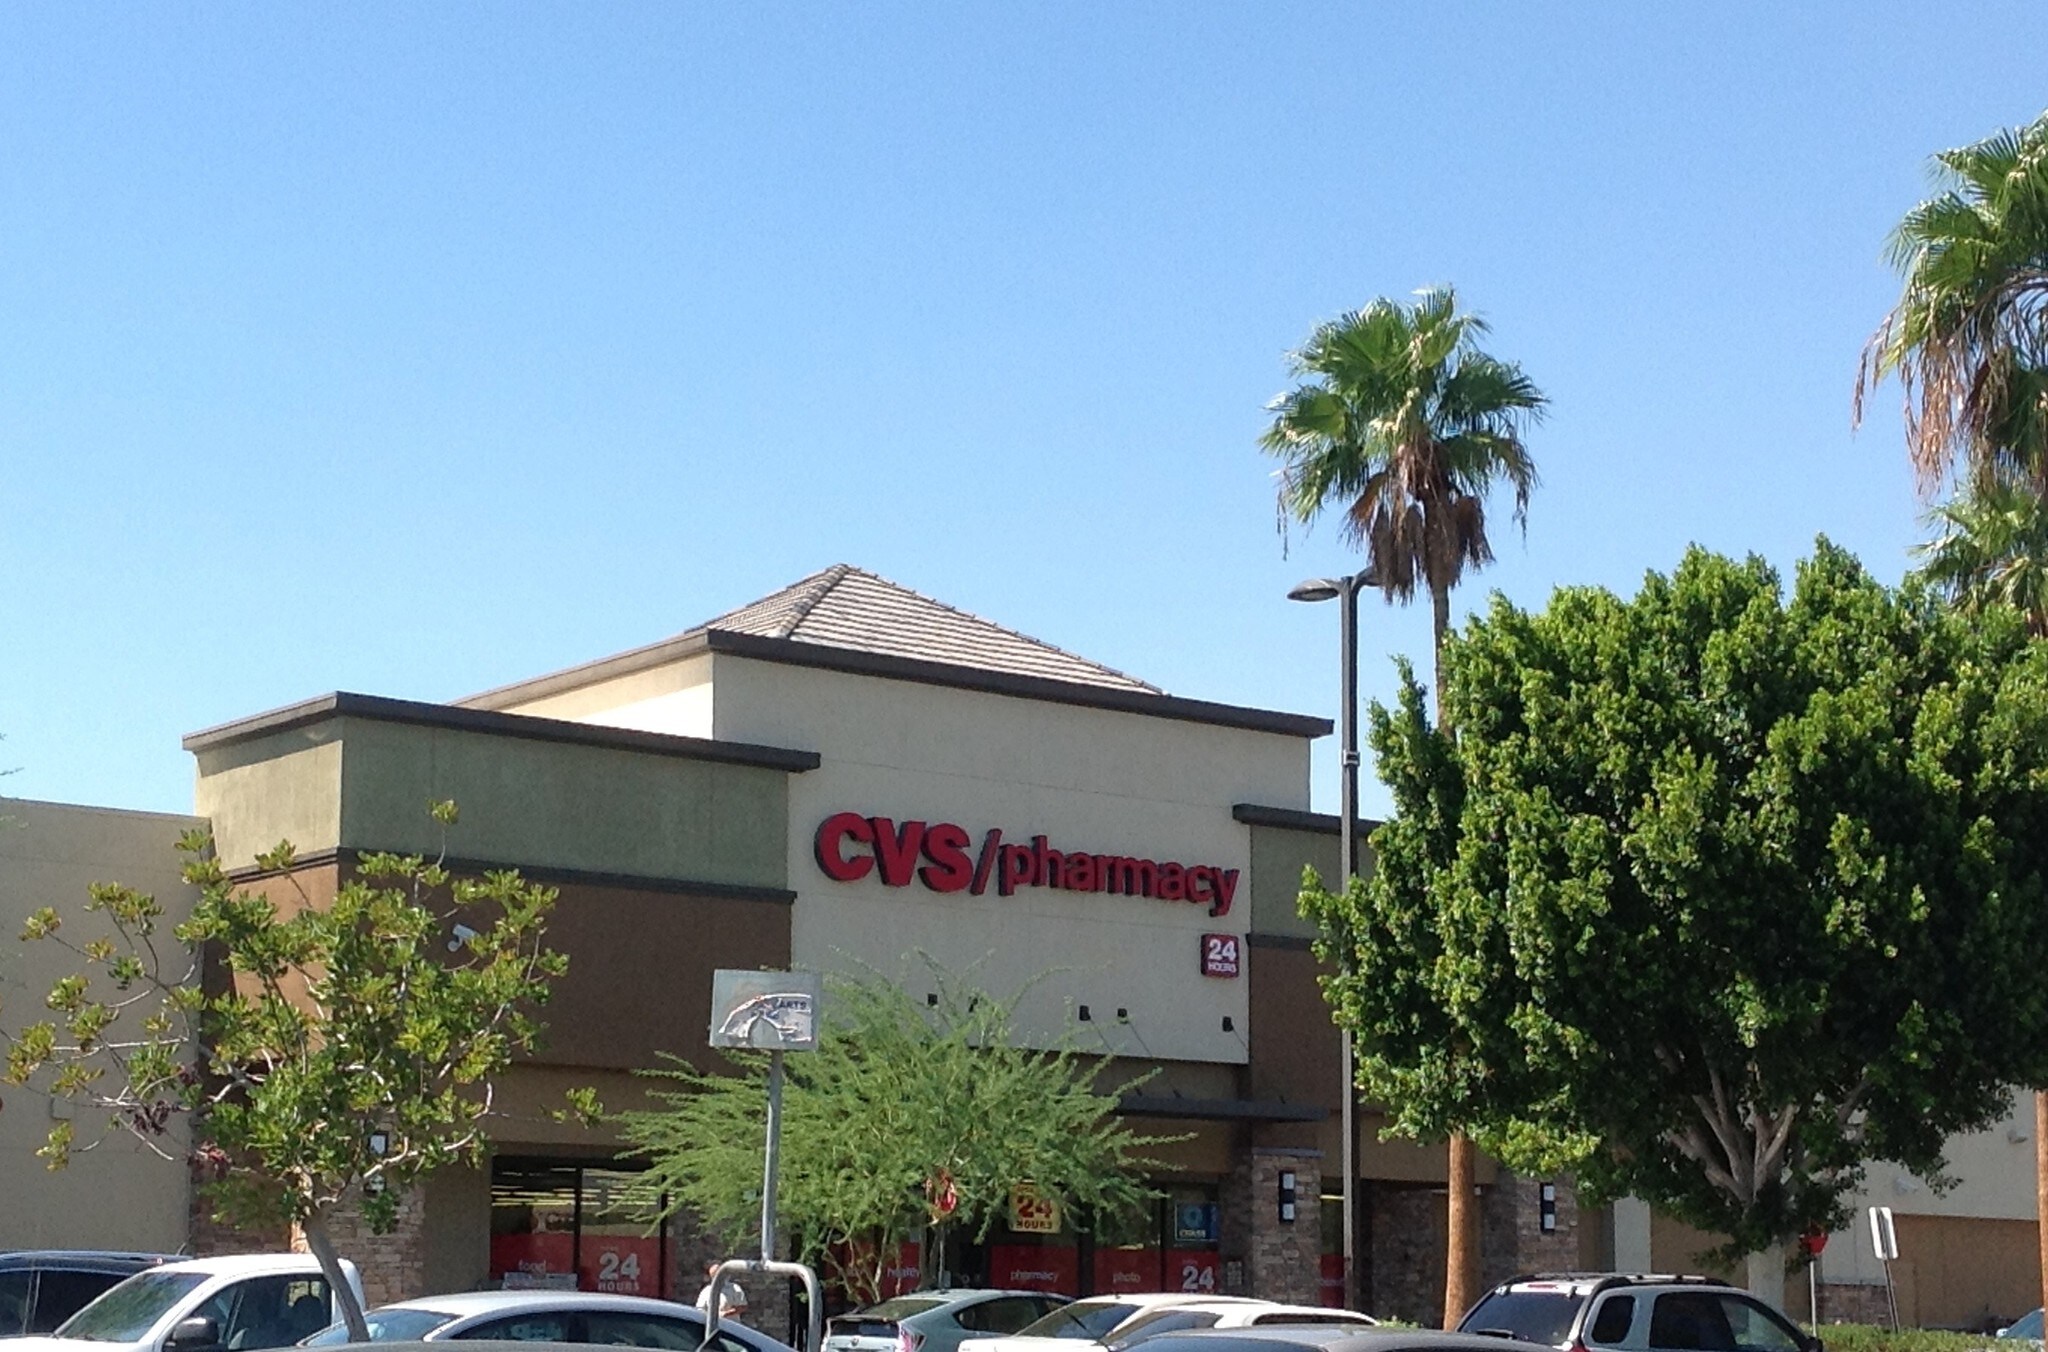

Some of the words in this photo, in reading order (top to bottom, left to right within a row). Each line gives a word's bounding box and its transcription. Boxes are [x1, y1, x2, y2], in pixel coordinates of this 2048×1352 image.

[1208, 938, 1236, 961] 24
[1015, 1195, 1053, 1218] 24
[599, 1251, 641, 1281] 24
[1010, 1269, 1059, 1283] pharmacy
[597, 1281, 641, 1292] HOURS
[1182, 1265, 1215, 1291] 24
